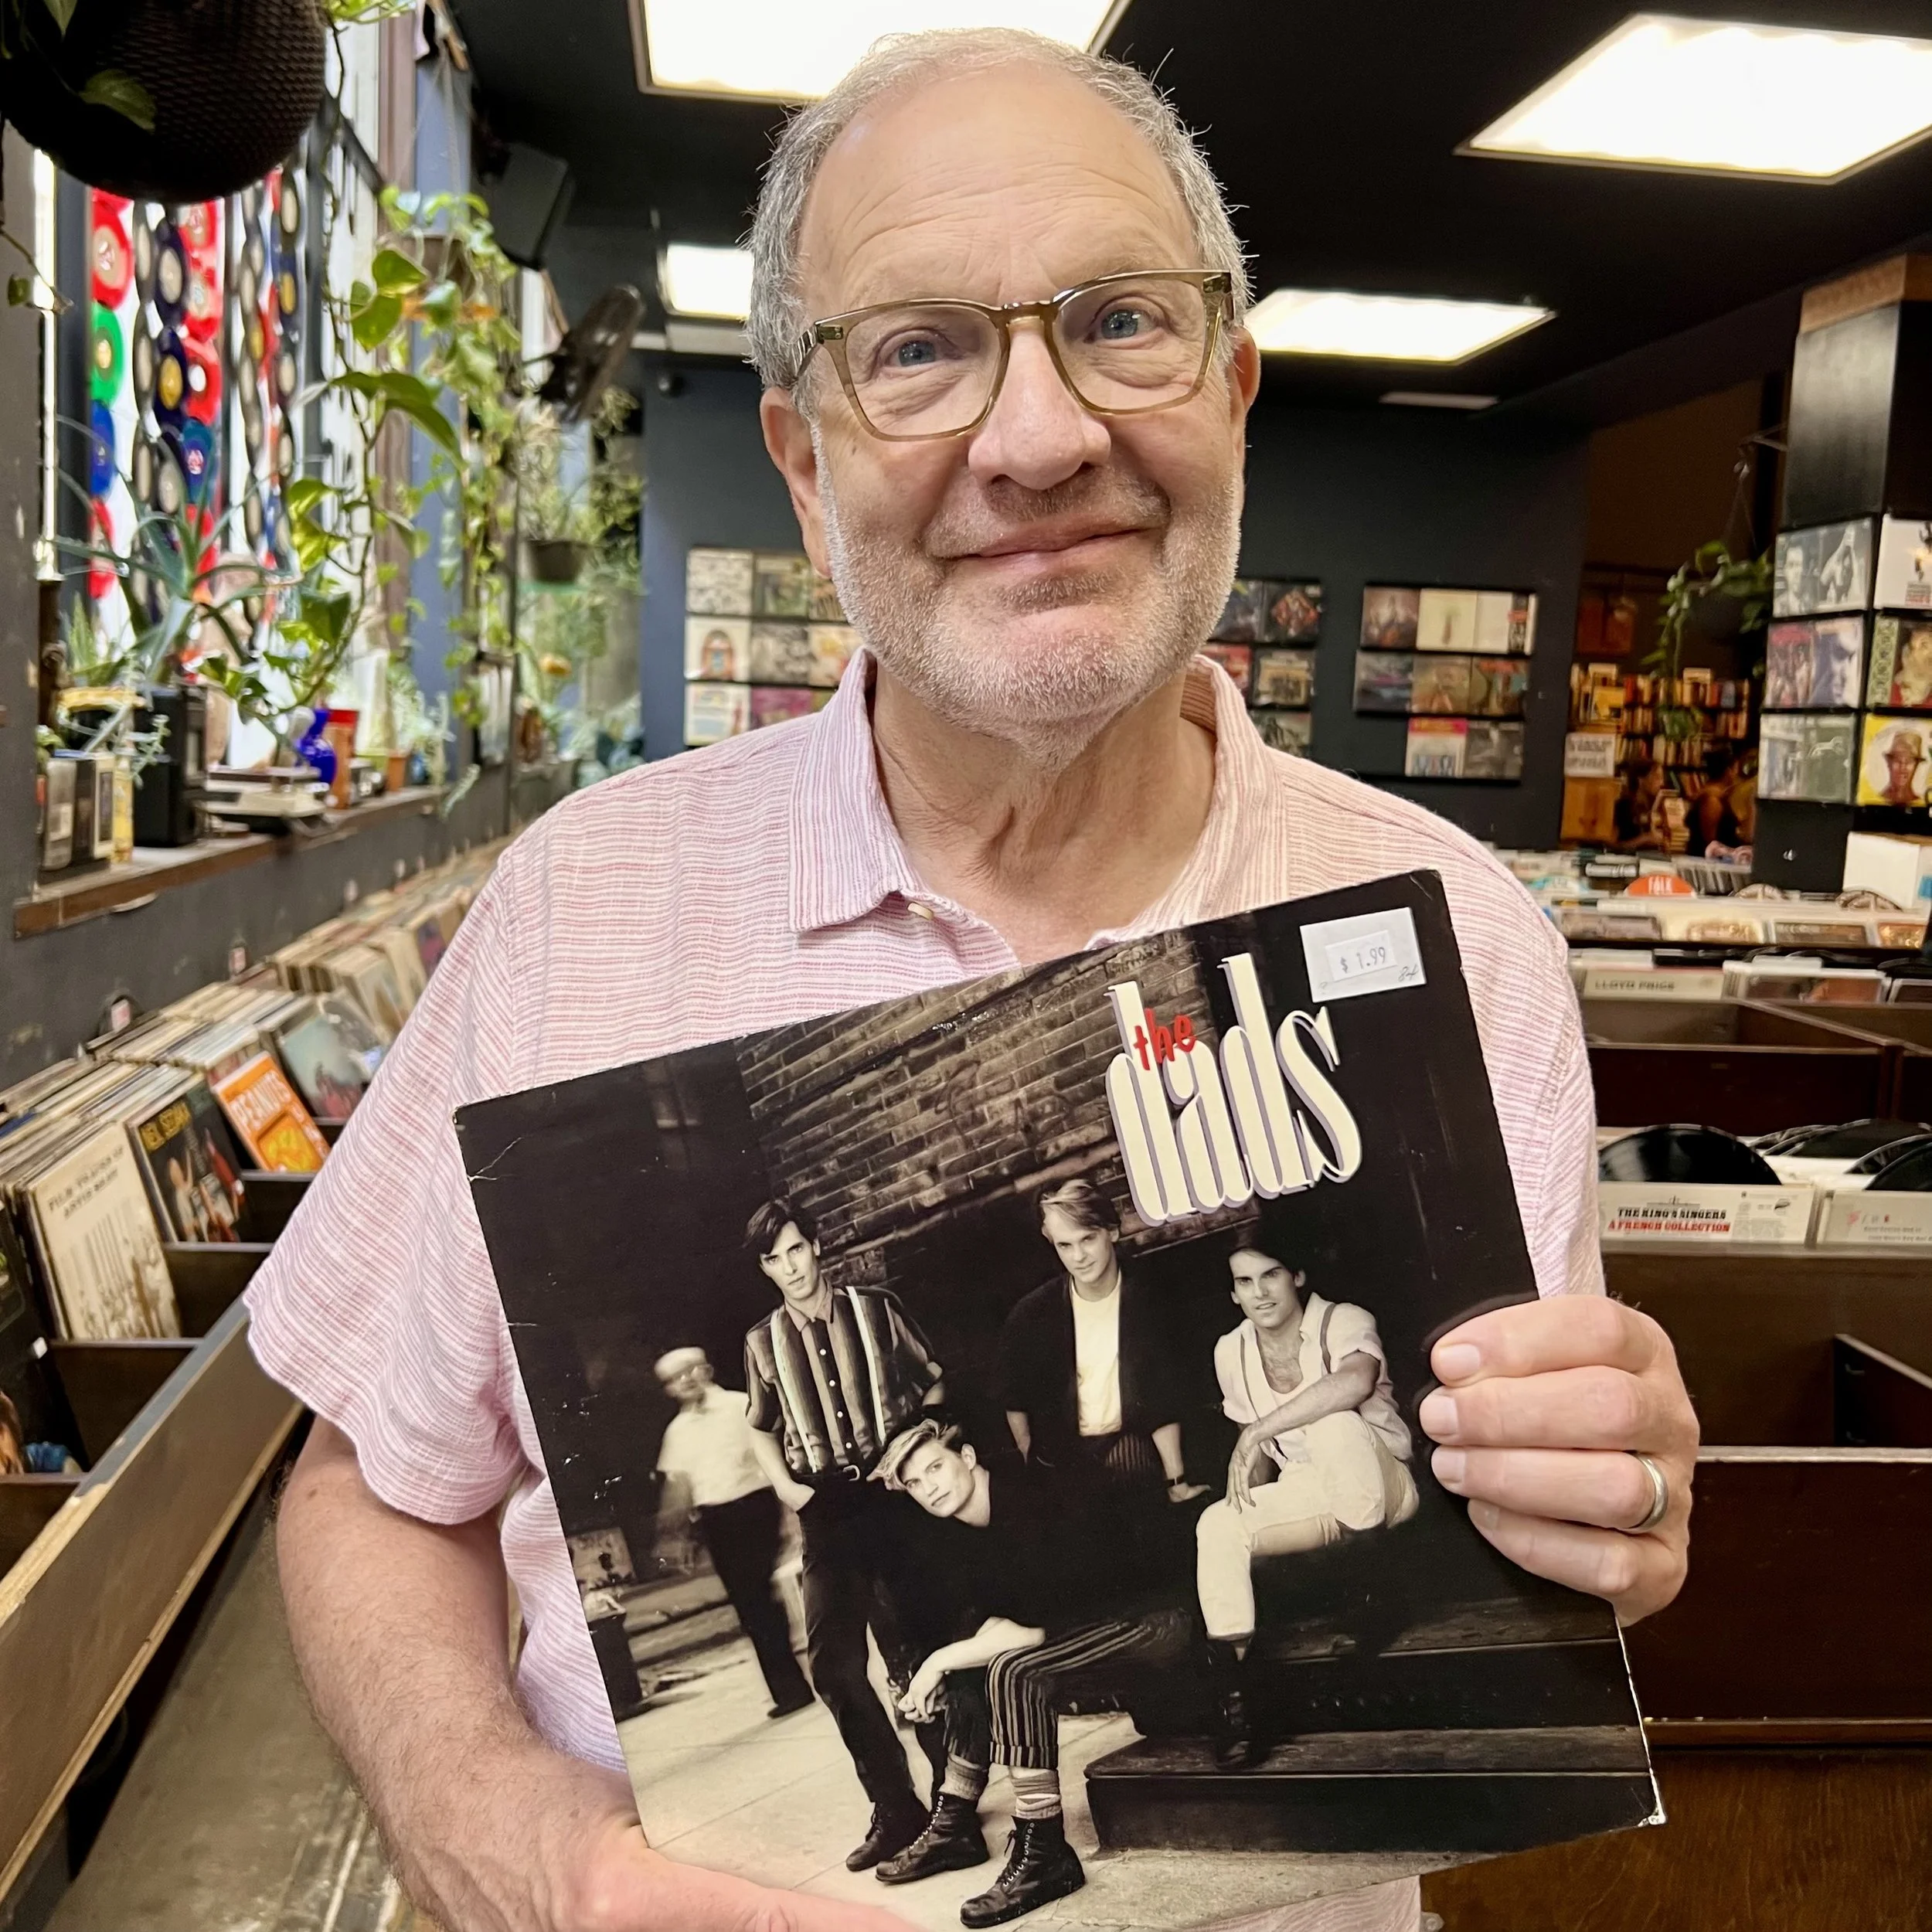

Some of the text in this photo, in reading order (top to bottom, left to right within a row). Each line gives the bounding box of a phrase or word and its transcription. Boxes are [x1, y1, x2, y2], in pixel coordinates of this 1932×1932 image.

[1340, 947, 1386, 973] $ 1.99
[1134, 1008, 1197, 1070] the
[1103, 952, 1362, 1227] dads
[1618, 1207, 1640, 1217] THE
[1679, 1209, 1727, 1219] SINGERS
[1608, 1220, 1615, 1230] A
[1617, 1220, 1662, 1230] FRENCH
[1665, 1221, 1731, 1233] COLLECTION
